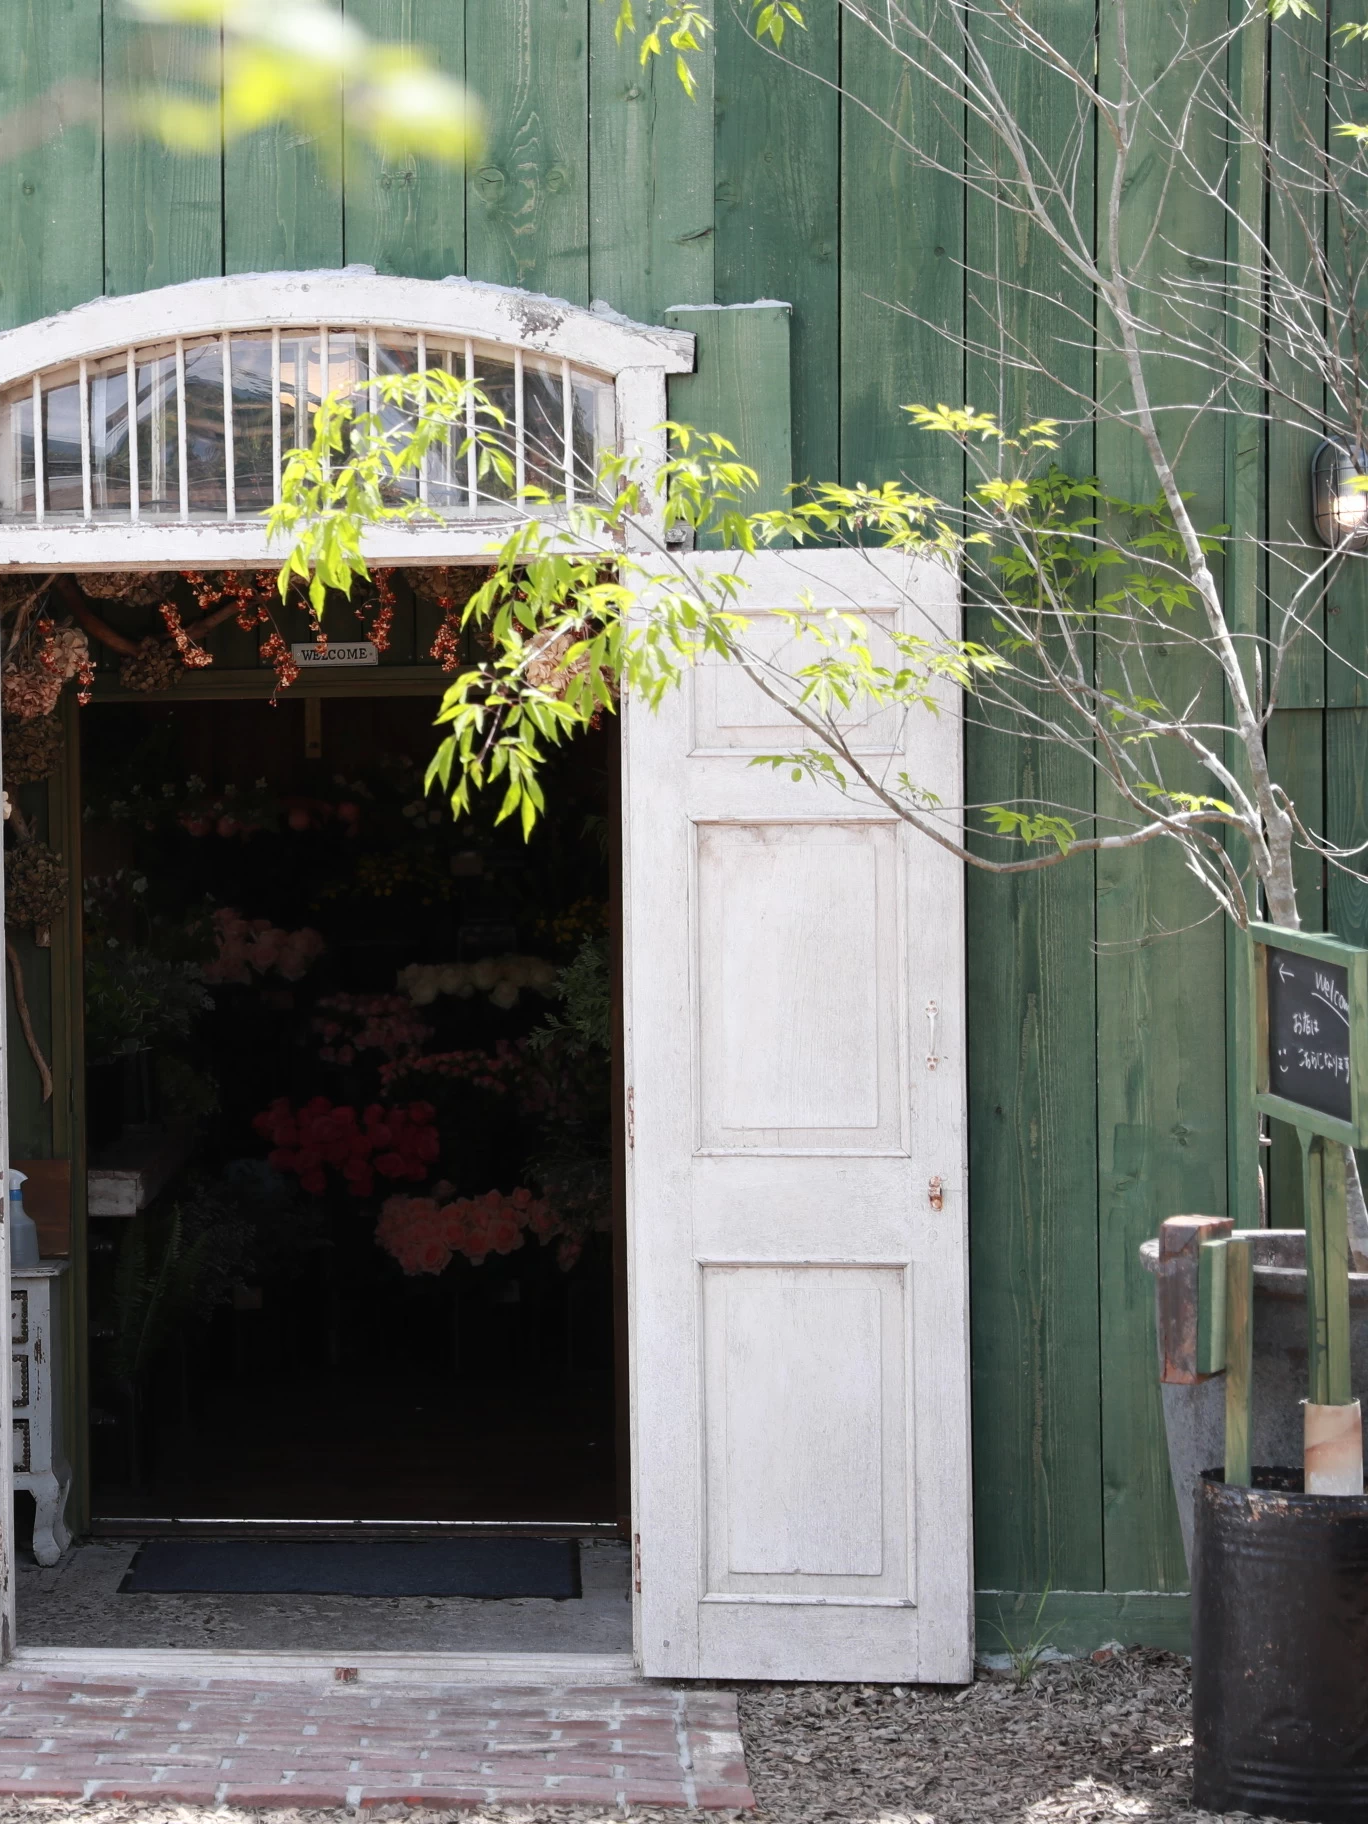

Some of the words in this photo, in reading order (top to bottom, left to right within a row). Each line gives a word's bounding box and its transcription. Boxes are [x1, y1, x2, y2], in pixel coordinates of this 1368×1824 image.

[1315, 971, 1350, 1011] Welcom
[1292, 1011, 1320, 1036] お店は
[1298, 1048, 1350, 1085] こちらになります
